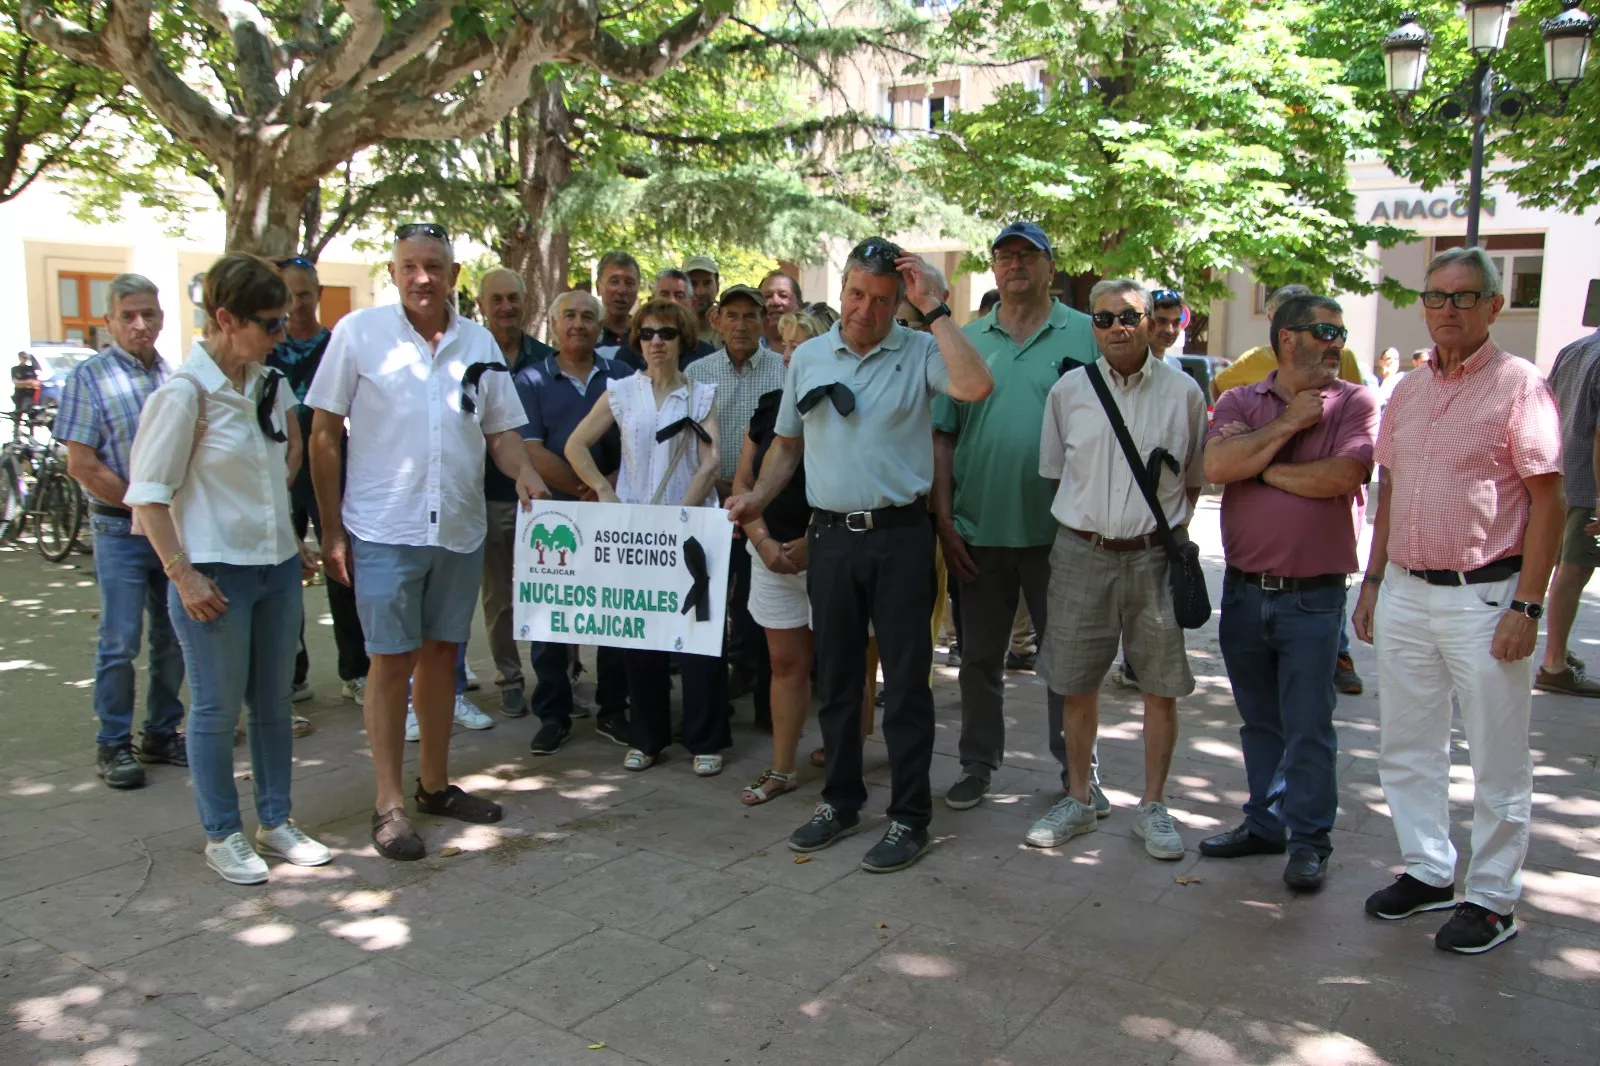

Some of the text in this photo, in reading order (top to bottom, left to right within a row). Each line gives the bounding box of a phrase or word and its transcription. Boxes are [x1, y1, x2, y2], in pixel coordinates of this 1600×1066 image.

[594, 530, 677, 546] ASOCIACIÓN
[594, 546, 677, 567] DE VECINOS
[541, 567, 575, 576] CAJICAR
[519, 582, 678, 613] NUCLEOS RURALES
[551, 611, 645, 639] EL CAJICAR
